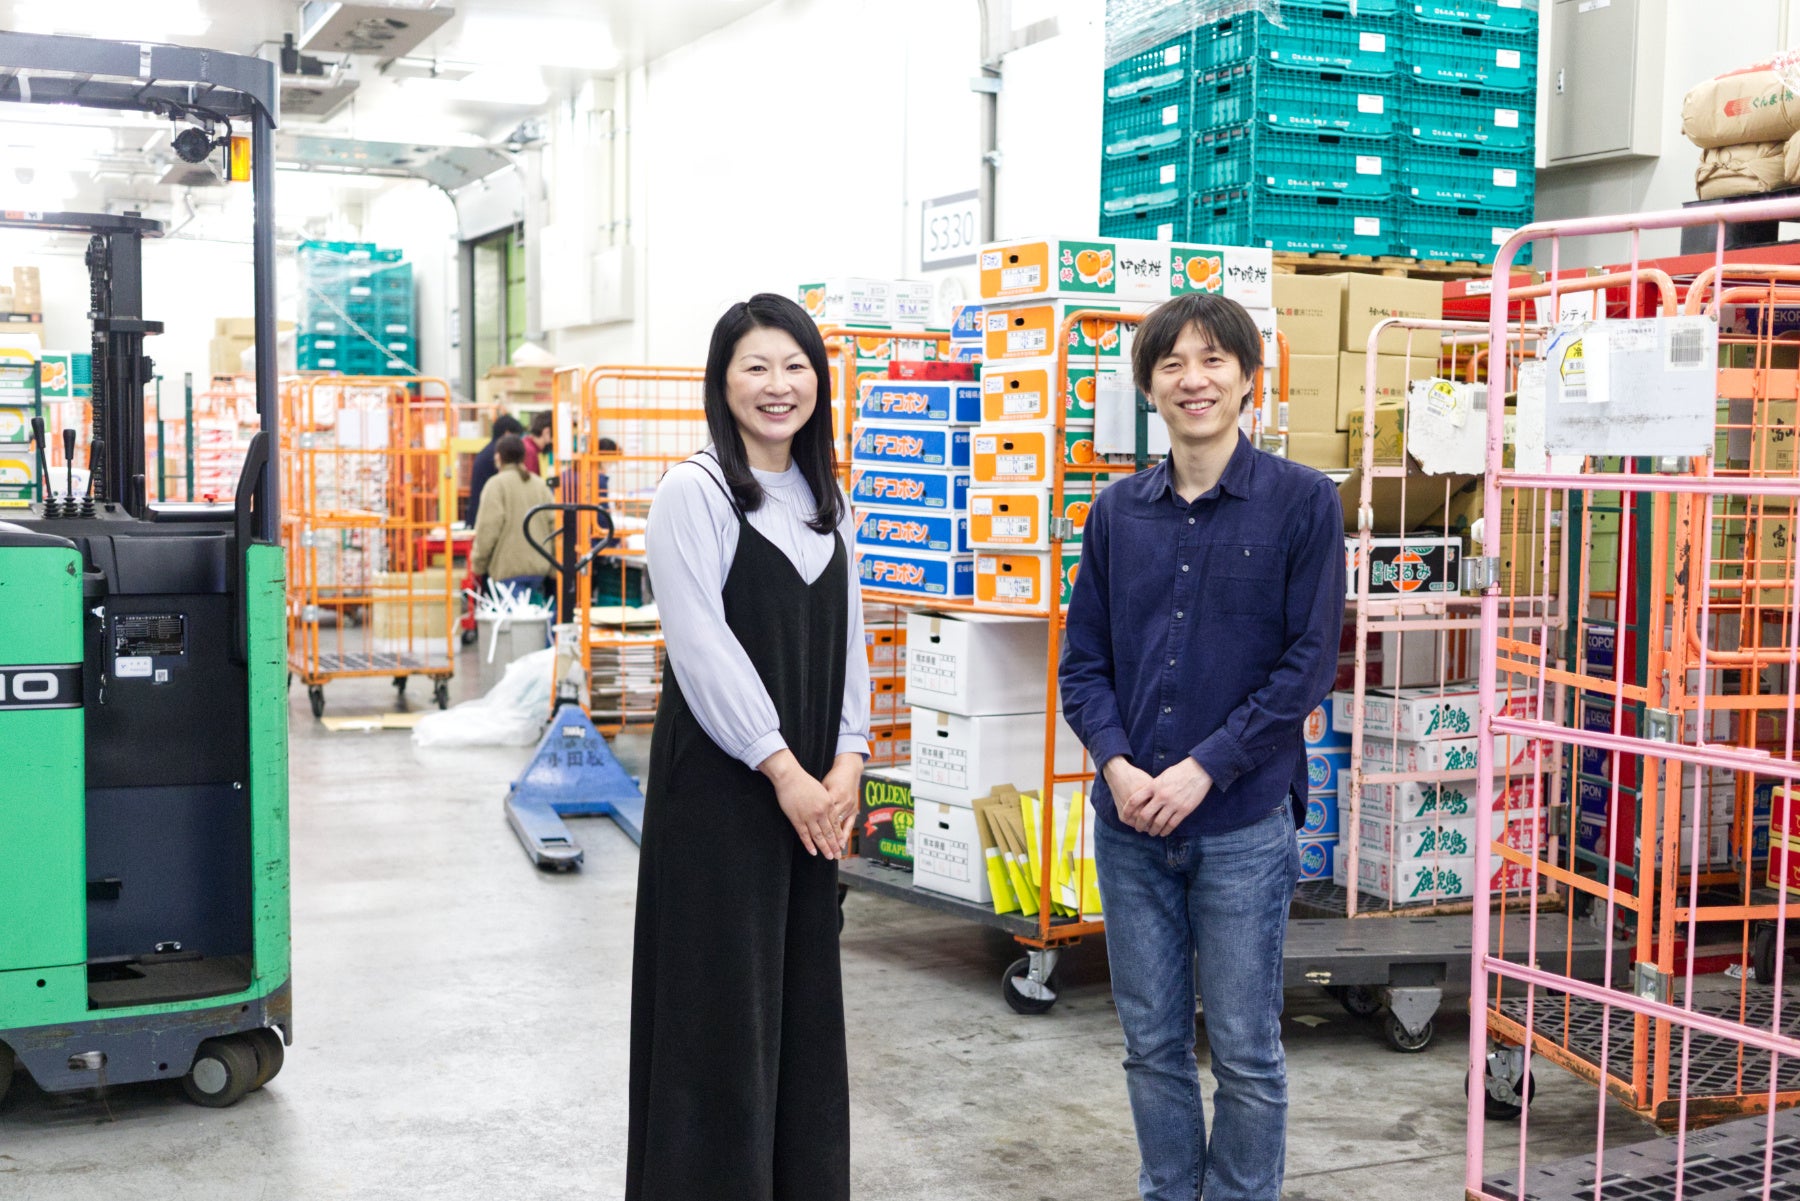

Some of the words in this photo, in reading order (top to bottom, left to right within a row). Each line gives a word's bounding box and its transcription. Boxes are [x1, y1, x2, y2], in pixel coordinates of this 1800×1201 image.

[930, 210, 974, 252] S330
[881, 391, 929, 414] デコポン
[874, 434, 924, 457] デコポン
[873, 476, 925, 500] デコポン
[877, 518, 929, 543] デコポン
[873, 560, 925, 585] デコポン
[1383, 562, 1432, 582] はるみ
[1424, 703, 1471, 736] 鹿児島
[865, 780, 907, 807] GOLDEN
[1414, 785, 1469, 818] 鹿児島
[1413, 825, 1469, 858] 鹿児島
[1409, 865, 1463, 898] 鹿児島
